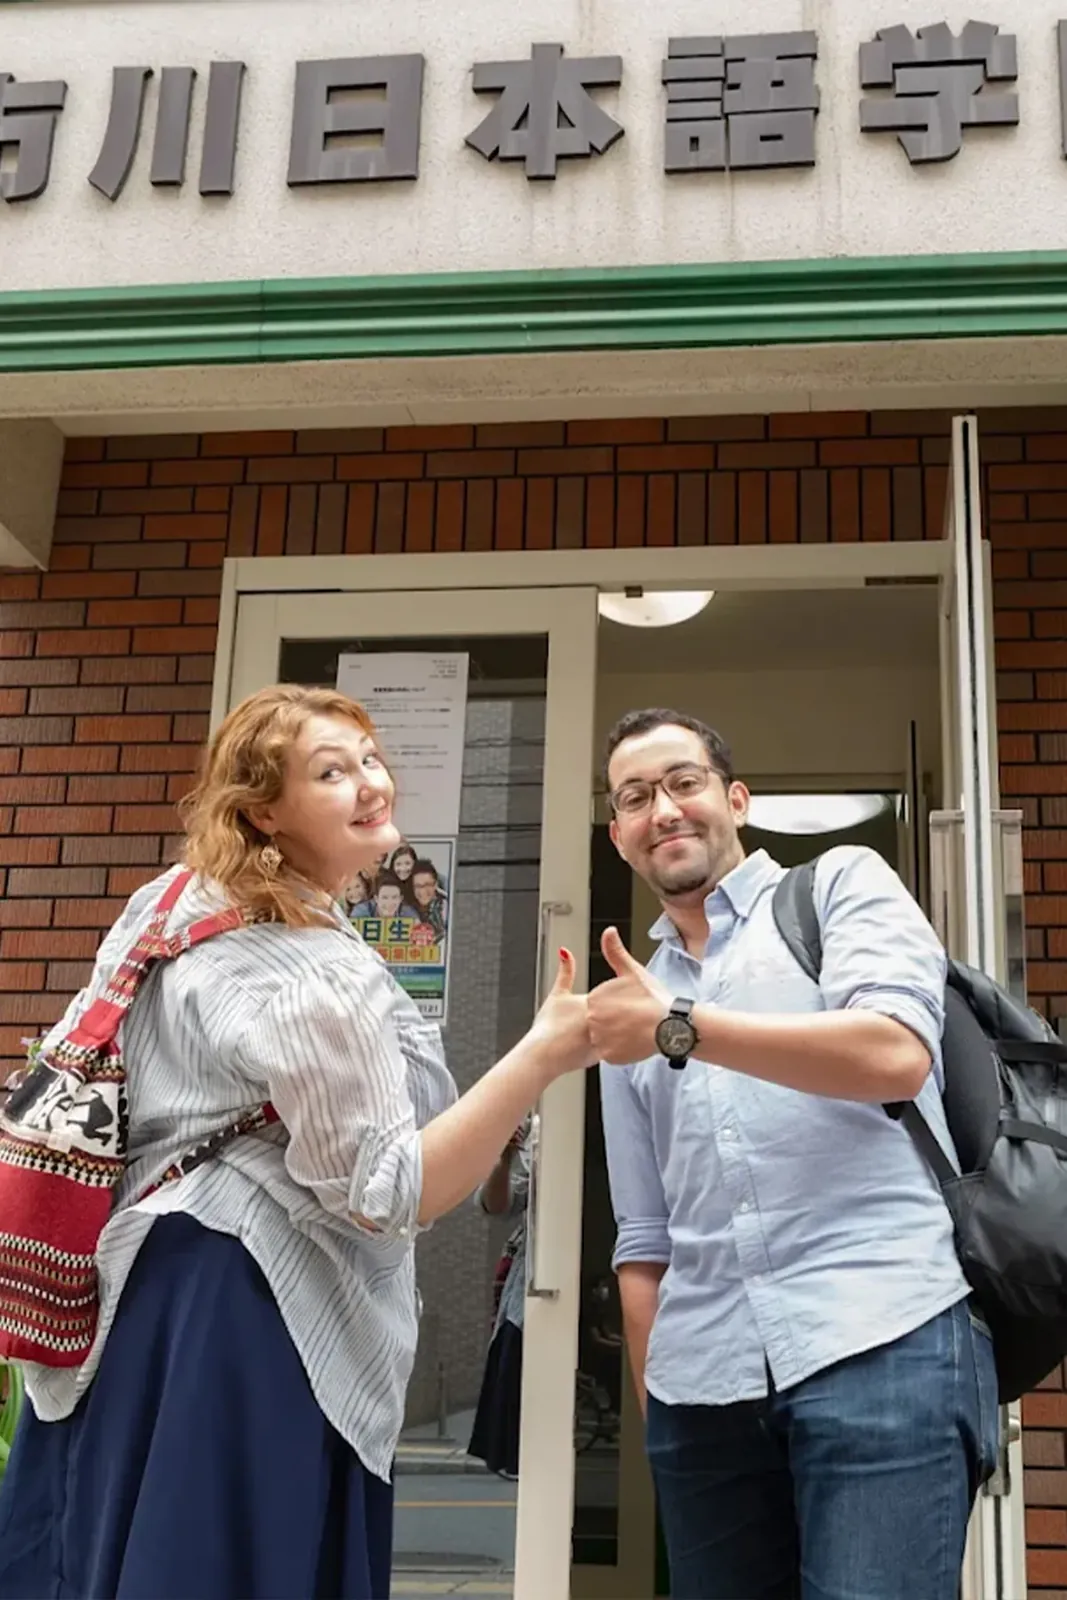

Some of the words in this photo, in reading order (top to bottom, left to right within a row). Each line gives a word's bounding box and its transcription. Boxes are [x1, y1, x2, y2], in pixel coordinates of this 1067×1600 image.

[0, 20, 1067, 203] 川日本語学
[351, 919, 410, 942] 日生
